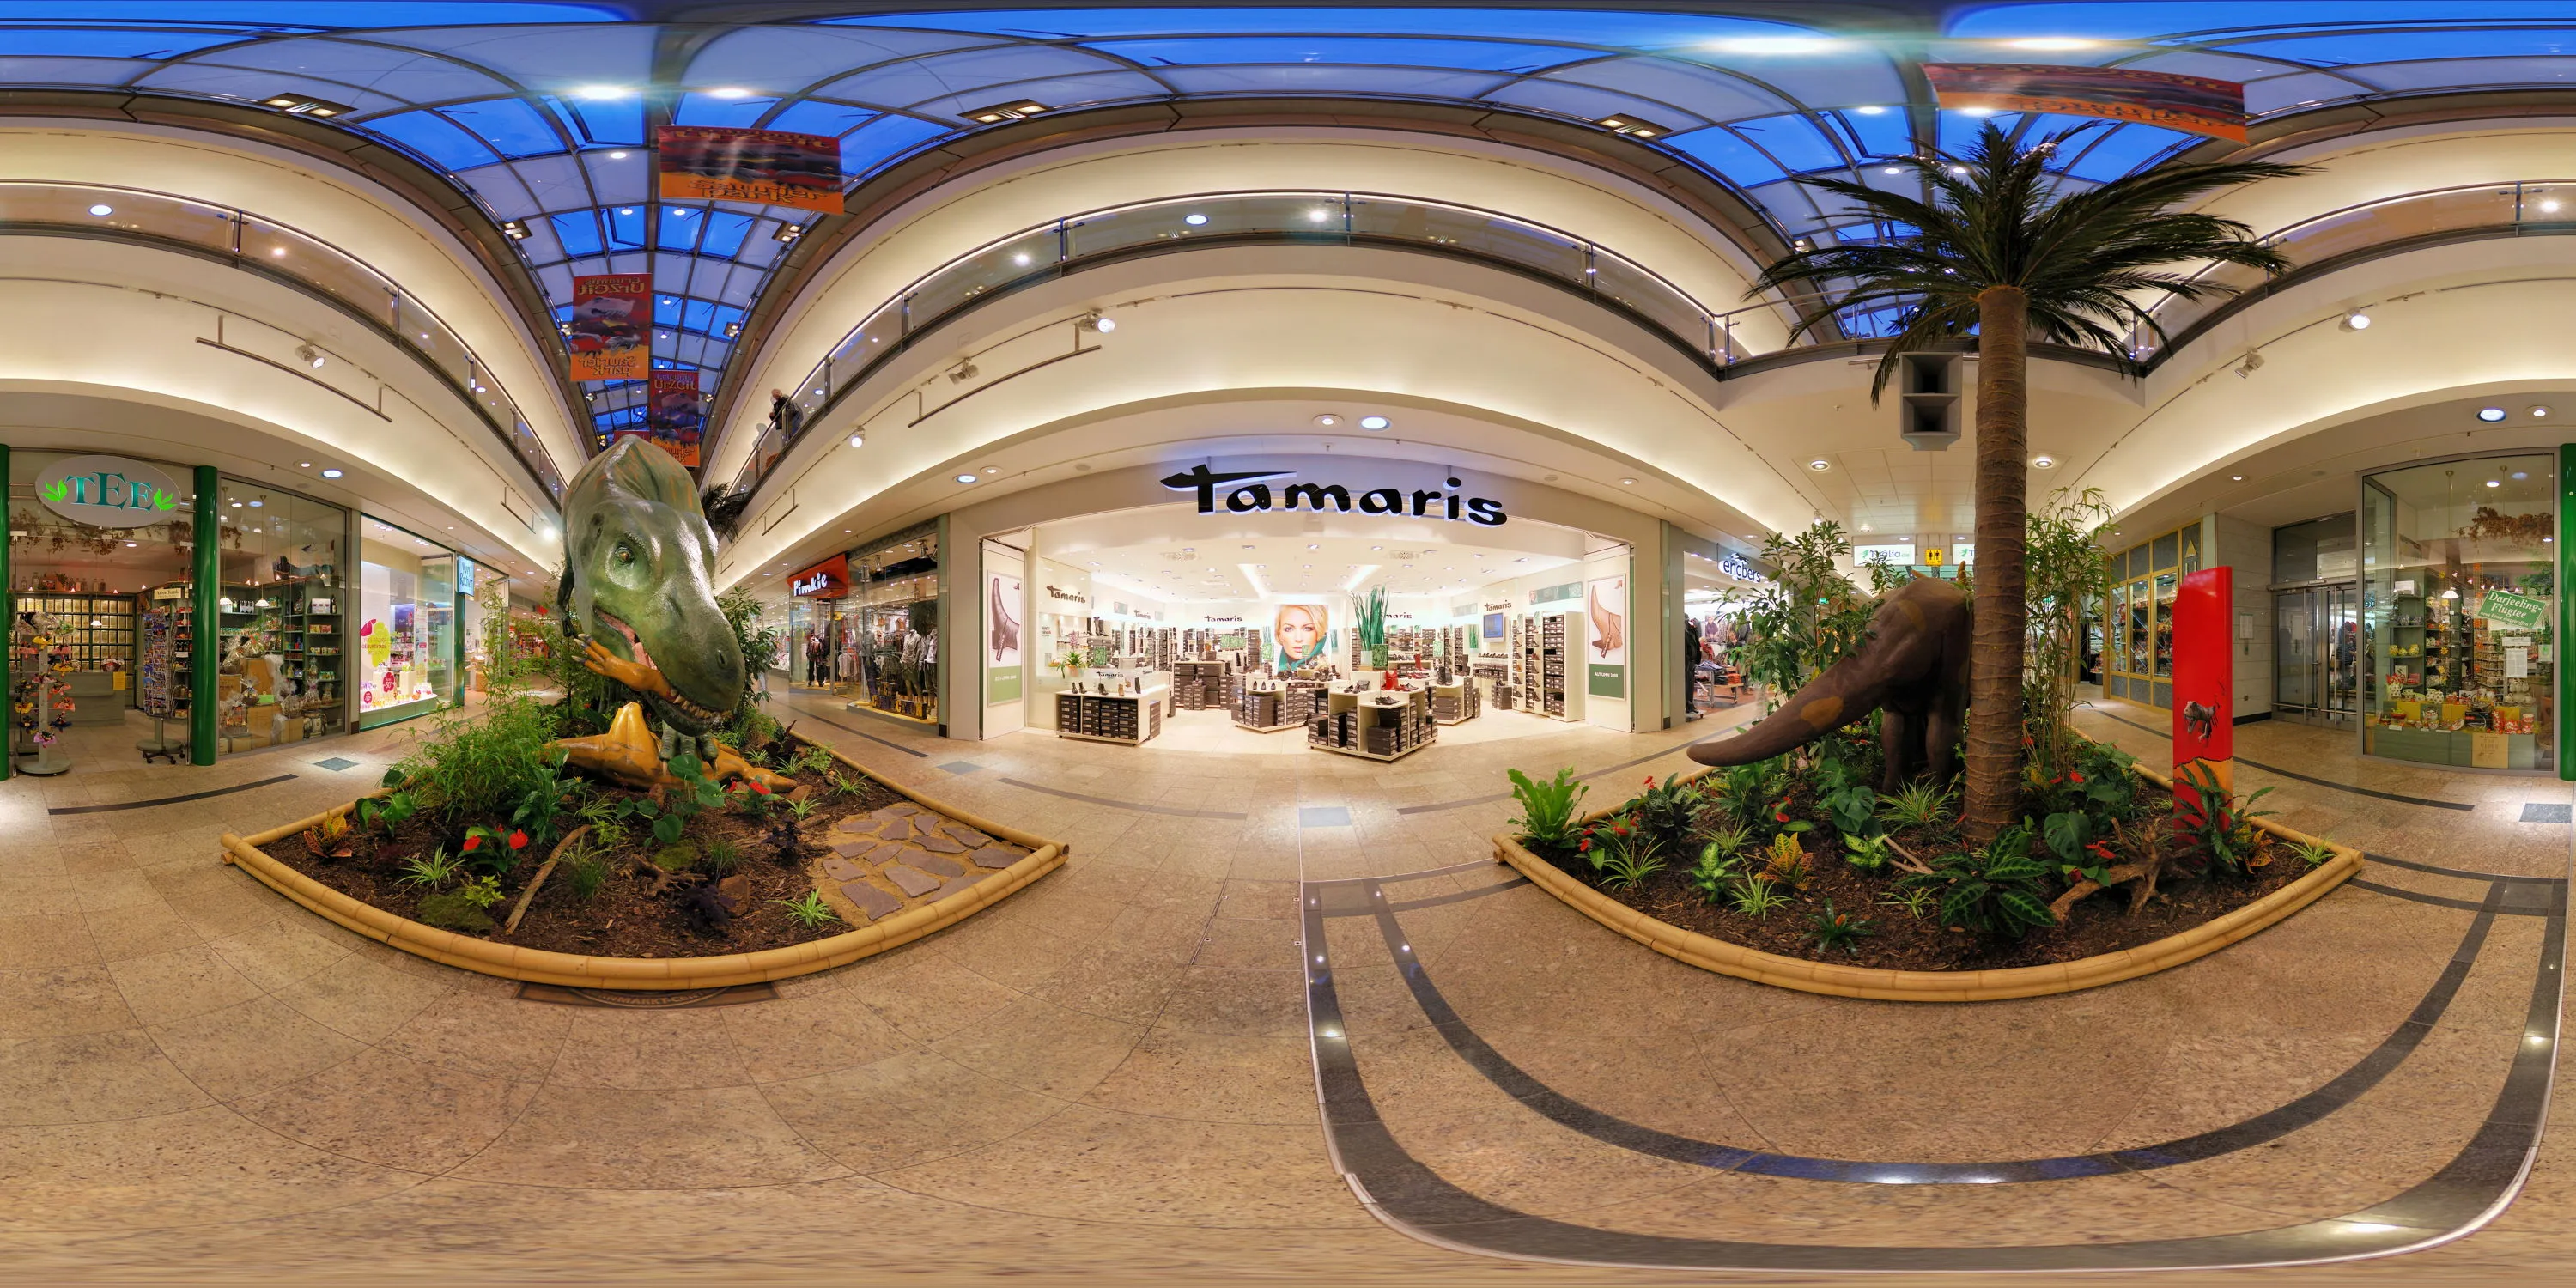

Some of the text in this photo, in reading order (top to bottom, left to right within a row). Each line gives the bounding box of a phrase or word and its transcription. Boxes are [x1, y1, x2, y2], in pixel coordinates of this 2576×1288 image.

[702, 188, 793, 203] park
[654, 380, 696, 390] Urzeit
[65, 471, 153, 512] TEE
[1160, 464, 1508, 528] Tamaris
[1723, 560, 1761, 583] engbers
[793, 572, 828, 597] Pimkie
[1047, 585, 1086, 604] Tamaris
[2489, 592, 2542, 612] Darjeeling-
[1133, 609, 1151, 620] Tamaris
[1484, 599, 1512, 612] Tamaris
[2491, 602, 2527, 618] Flugtee
